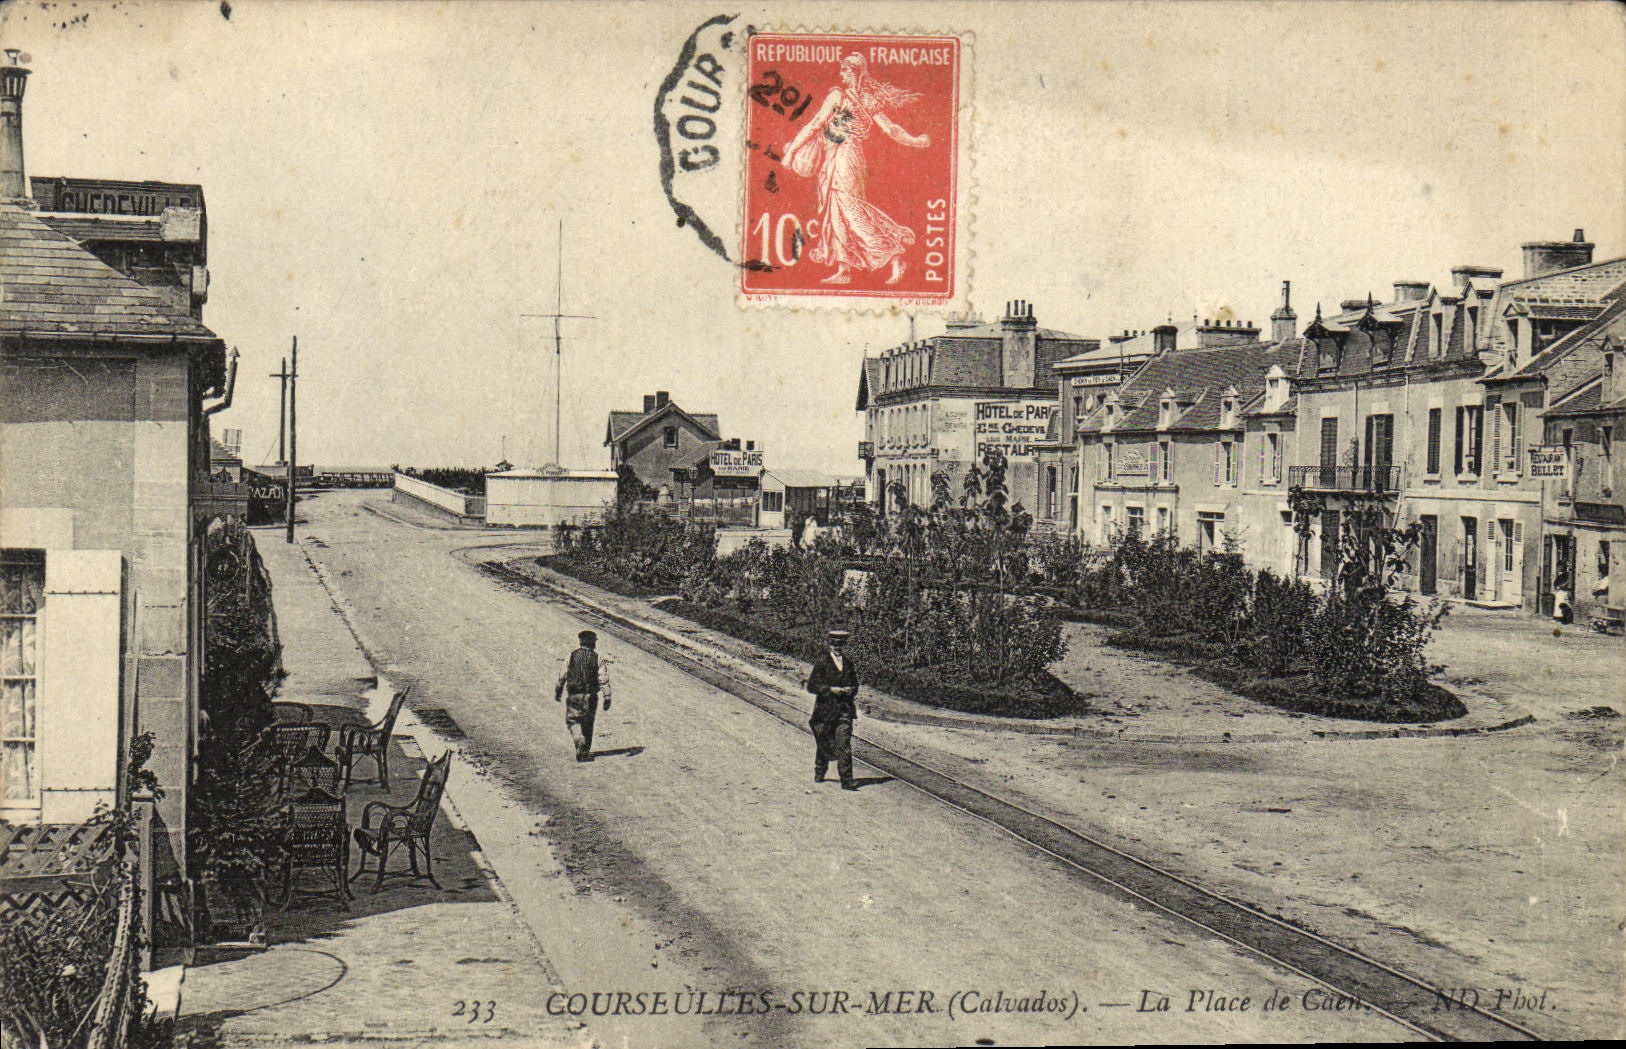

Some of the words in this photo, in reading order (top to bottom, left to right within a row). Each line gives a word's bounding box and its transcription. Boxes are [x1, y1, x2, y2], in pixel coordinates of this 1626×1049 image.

[756, 44, 843, 63] REPUBLIQUE
[870, 47, 950, 66] FRANÇAISE
[925, 198, 946, 282] POSTES
[1013, 410, 1024, 418] DE
[1026, 404, 1051, 420] PARI
[734, 457, 741, 465] DE
[743, 451, 762, 466] PARIS
[1531, 453, 1564, 464] RESTAURANT
